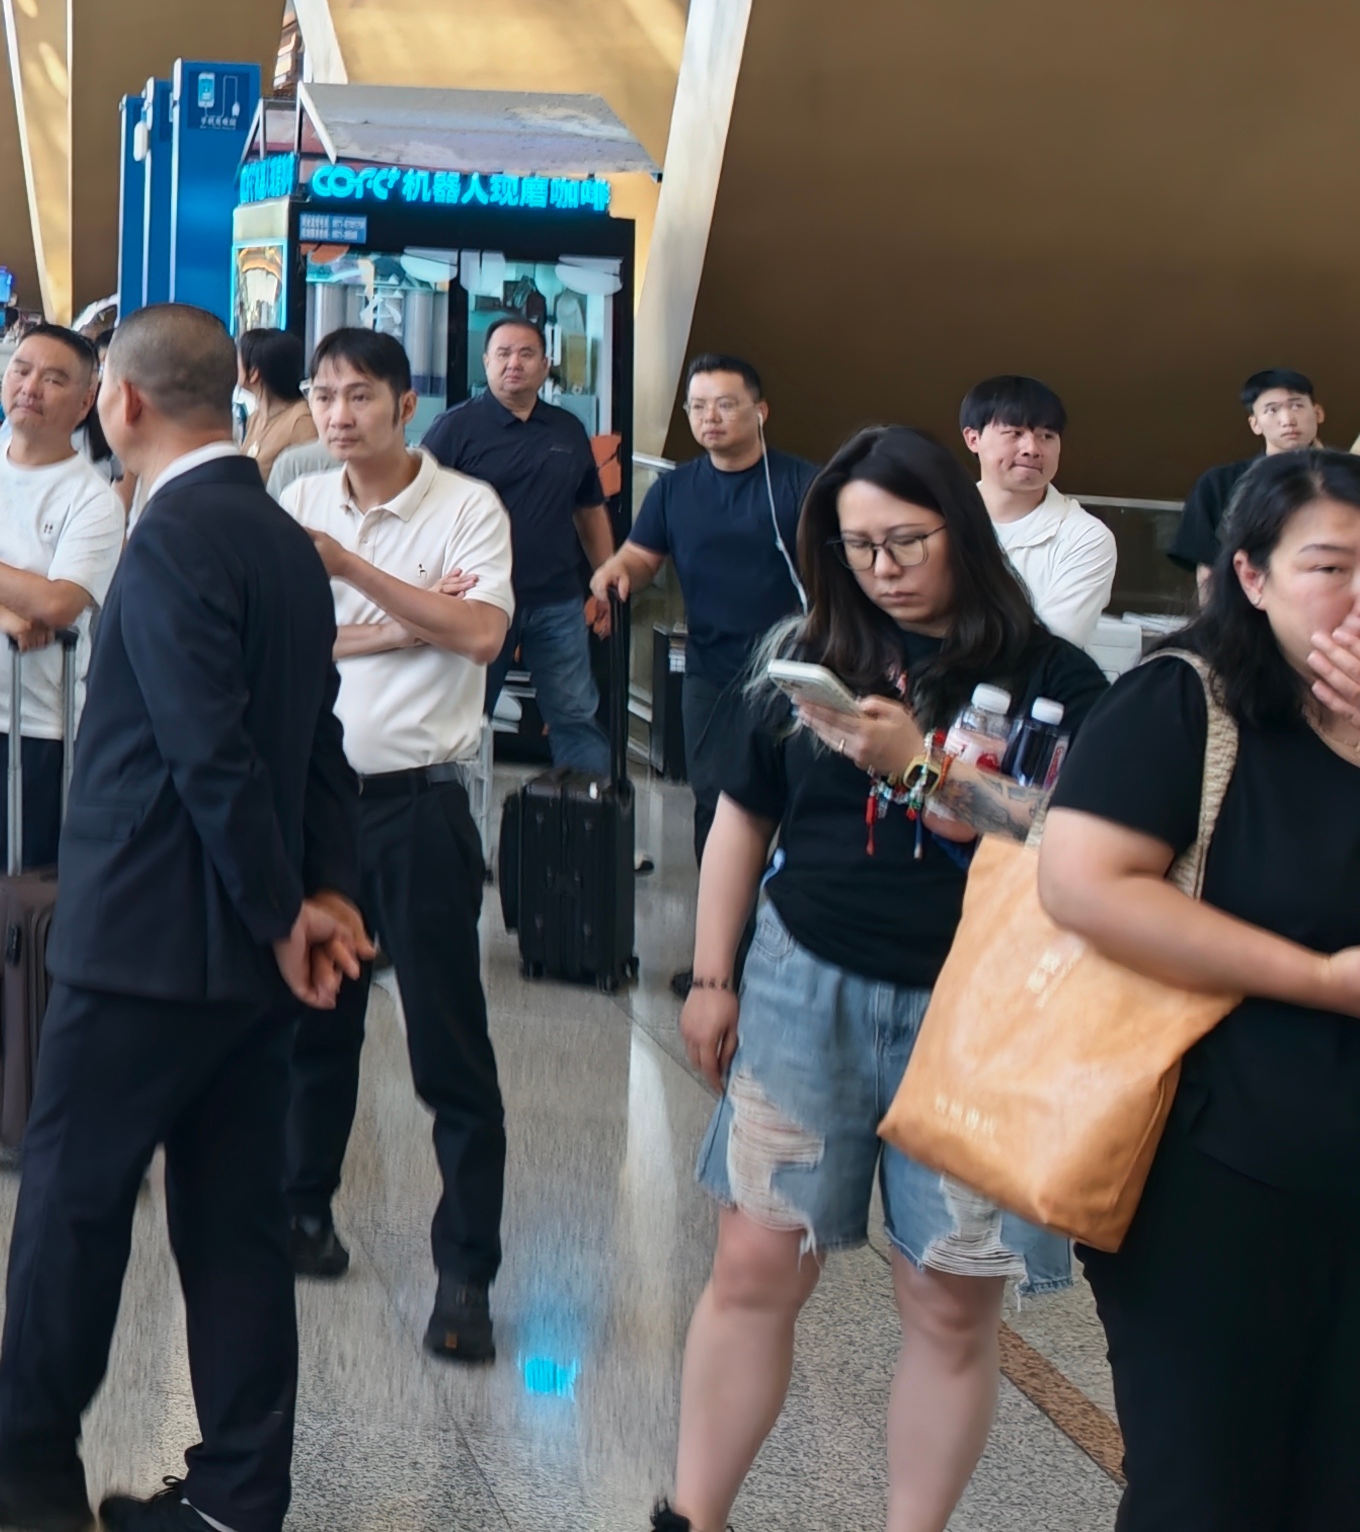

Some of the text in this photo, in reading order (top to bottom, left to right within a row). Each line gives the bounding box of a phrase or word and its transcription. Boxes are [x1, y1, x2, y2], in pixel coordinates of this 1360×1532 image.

[402, 168, 610, 211] 机器人现磨咖啡
